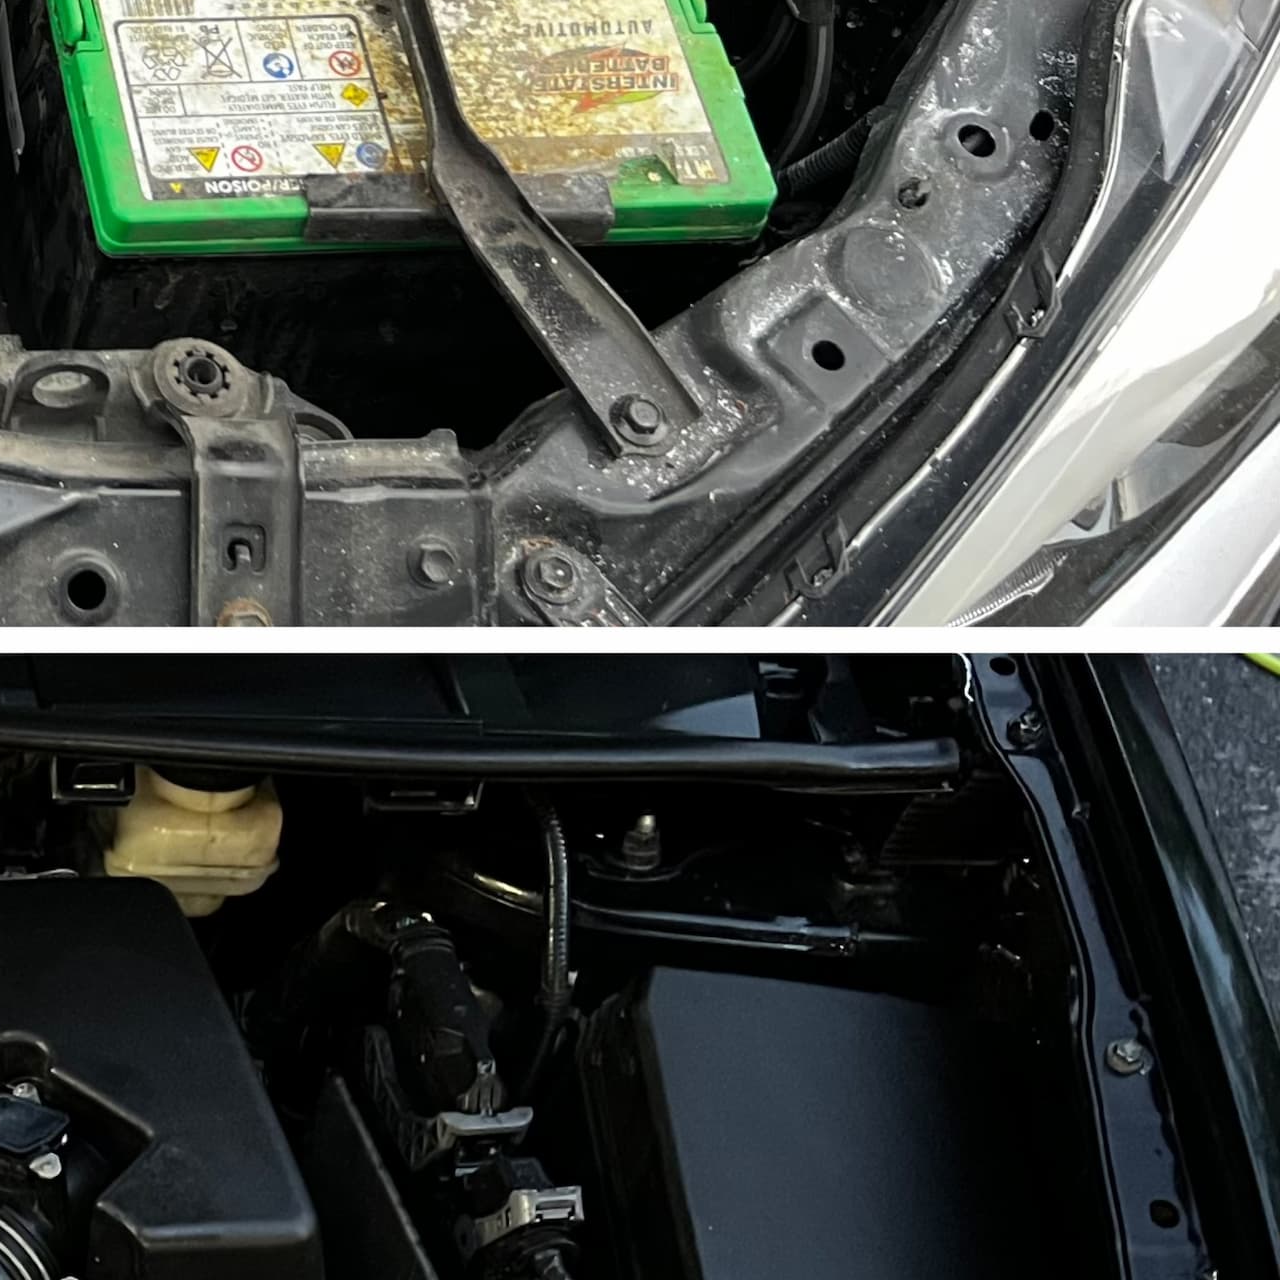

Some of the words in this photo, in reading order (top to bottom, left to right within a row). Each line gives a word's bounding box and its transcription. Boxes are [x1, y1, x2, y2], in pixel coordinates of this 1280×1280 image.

[199, 25, 220, 34] Pb
[522, 19, 652, 37] AUTOMOTIVE
[531, 73, 676, 91] INTERSTATE
[204, 179, 304, 194] ER/POISON
